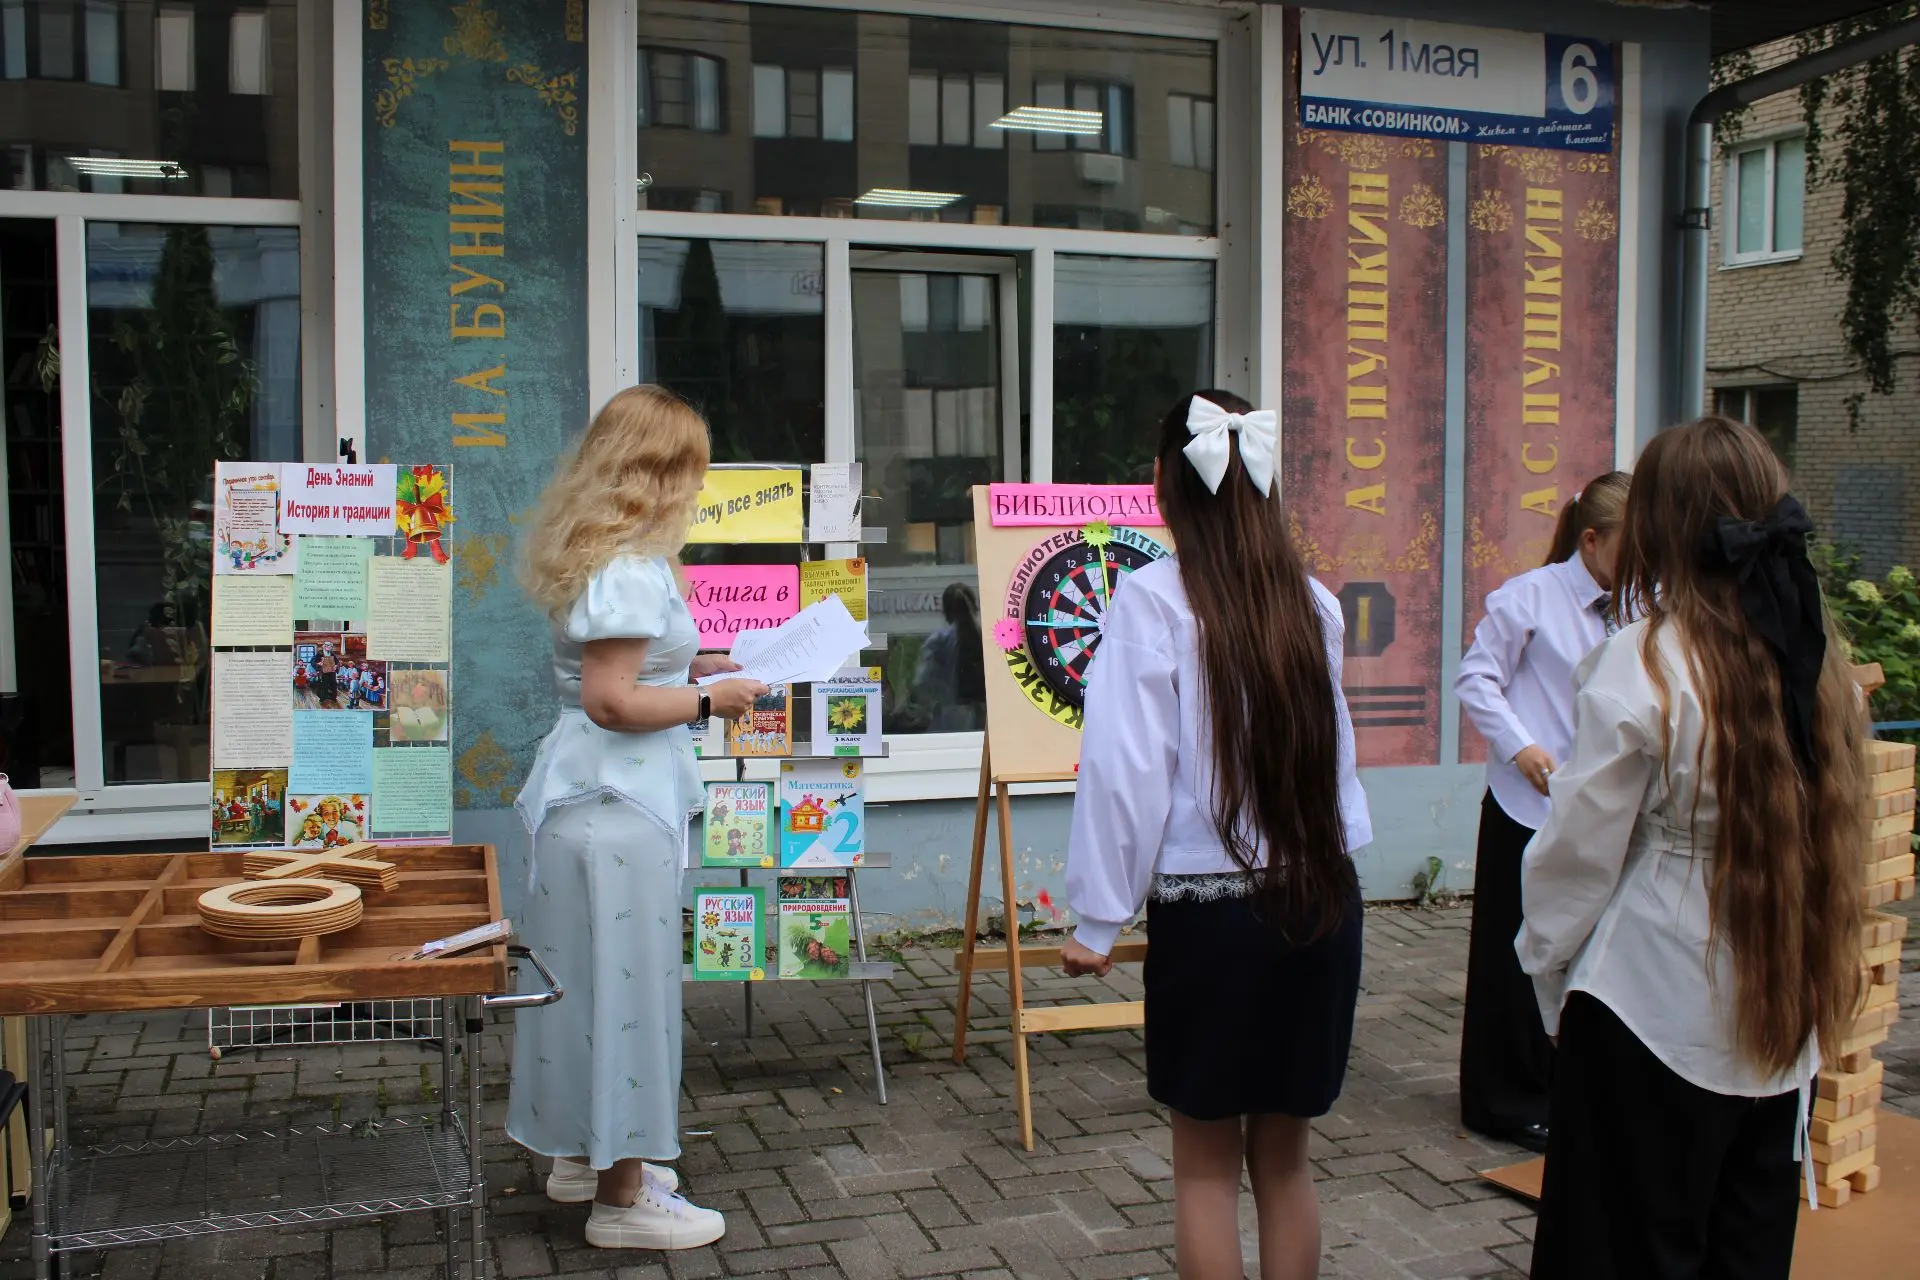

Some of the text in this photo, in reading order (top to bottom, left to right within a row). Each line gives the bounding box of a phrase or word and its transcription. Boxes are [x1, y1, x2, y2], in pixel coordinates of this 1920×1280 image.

[1311, 32, 1366, 75] ул.
[1560, 43, 1598, 114] 6
[1305, 105, 1470, 134] БАНК «СОВИНКОМ»
[1476, 124, 1516, 137] Живем
[1538, 121, 1592, 135] работаем
[1565, 132, 1607, 145] вместе!
[449, 140, 505, 339] БУНИН
[1346, 171, 1390, 420] ПУШКИН
[1522, 187, 1564, 426] ПУШКИН
[306, 468, 374, 488] День Знаний
[727, 494, 751, 515] все
[756, 482, 794, 506] знать
[995, 494, 1158, 518] БИБЛИОДАР
[287, 500, 330, 522] История
[333, 505, 340, 518] и
[342, 505, 391, 523] традиции
[1066, 560, 1077, 568] 12
[1086, 553, 1093, 561] 5
[1104, 552, 1115, 562] 20
[1126, 557, 1131, 566] 1
[804, 569, 840, 579] ВЫУЧИТЬ
[1007, 529, 1085, 618] БИБЛИОТЕКА
[1054, 573, 1060, 582] 9
[686, 580, 789, 608] Книга в
[1041, 590, 1051, 599] 14
[694, 609, 791, 634] одарок
[1038, 613, 1047, 622] 11
[1042, 635, 1048, 644] 8
[1048, 657, 1059, 666] 16
[1005, 643, 1084, 729] КАЗКИ
[1064, 676, 1070, 685] 7
[715, 784, 766, 799] РУССКИЙ
[788, 780, 854, 790] Математика
[735, 800, 765, 811] ЯЗЫК
[833, 811, 862, 852] 2
[752, 831, 764, 850] 3
[705, 896, 753, 911] РУССКИЙ
[782, 904, 847, 912] ПРИРОДОВЕДЕНИЕ
[724, 910, 753, 922] ЯЗЫК
[809, 913, 822, 931] 5
[740, 943, 752, 963] 3
